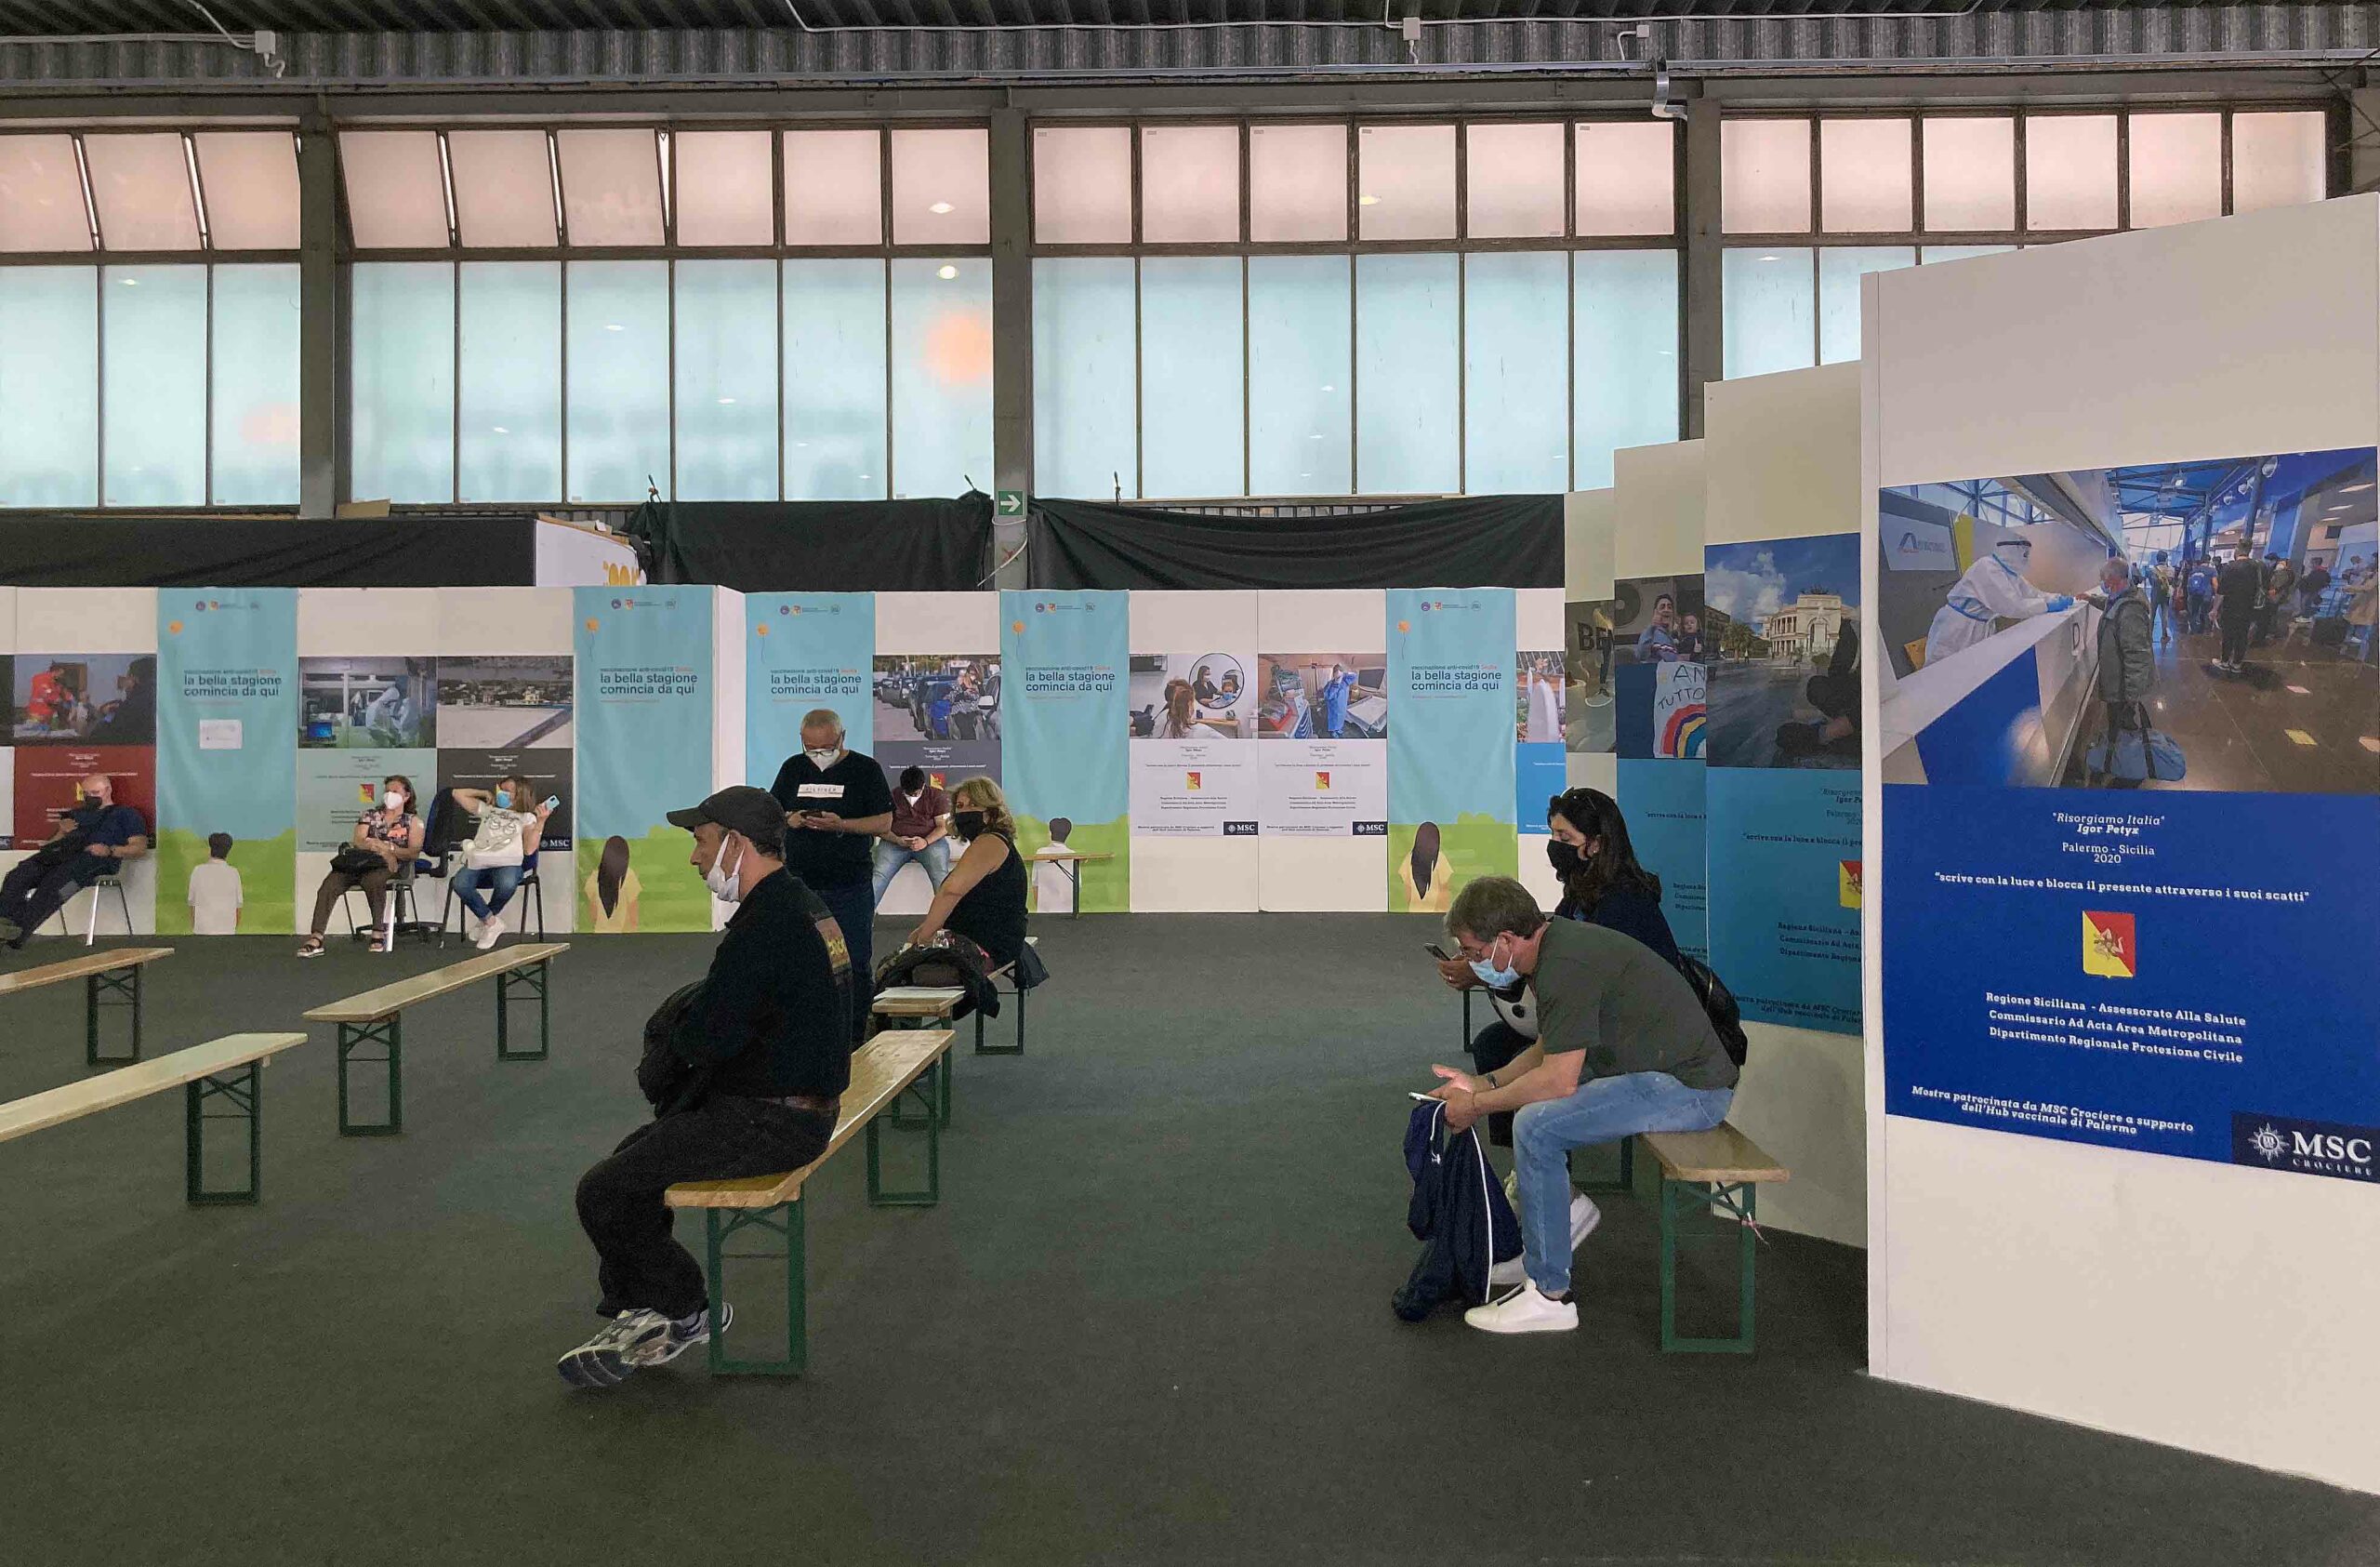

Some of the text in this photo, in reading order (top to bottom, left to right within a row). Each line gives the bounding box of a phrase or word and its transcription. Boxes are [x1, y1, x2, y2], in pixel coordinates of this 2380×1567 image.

[184, 675, 282, 687] la bella stagione
[600, 672, 698, 684] la bella stagione
[771, 674, 862, 684] la bella stagione
[1025, 671, 1116, 683] la bella stagione
[1411, 671, 1501, 682] la bella stagione
[184, 686, 279, 697] comincia da qui
[601, 684, 694, 696] comincia da qui
[771, 684, 859, 696] comincia da qui
[1025, 682, 1112, 692] comincia da qui
[1411, 681, 1499, 692] comincia da qui
[1659, 687, 1705, 710] TUTTO
[2053, 812, 2165, 826] "Risorgiamo Italia"
[2077, 823, 2139, 837] Igor Petyx
[549, 839, 570, 847] MSC
[2062, 842, 2109, 854] Palermo
[2119, 844, 2155, 855] Sicilia
[2094, 853, 2122, 864] 2020
[1935, 871, 2309, 902] "scrive con la luce e blocca il presente attraverso i suoi scatti"
[1986, 991, 2031, 1006] Regione
[2033, 996, 2086, 1012] Siciliana
[2098, 1003, 2173, 1020] Assessorato
[2175, 1010, 2202, 1023] Alla
[2204, 1013, 2246, 1026] Salute
[1989, 1009, 2242, 1045] Commissario Ad Acta Area Metropolitana
[1989, 1026, 2243, 1064] Dipartimento Regionale Protezione Civile
[1911, 1085, 2194, 1133] Mostra patrocinata da MSC Crociere a supporto
[1961, 1102, 2137, 1135] dell'Hub vaccinale di Palermo
[2292, 1130, 2373, 1163] MSC
[2293, 1158, 2373, 1177] CROCIERE
